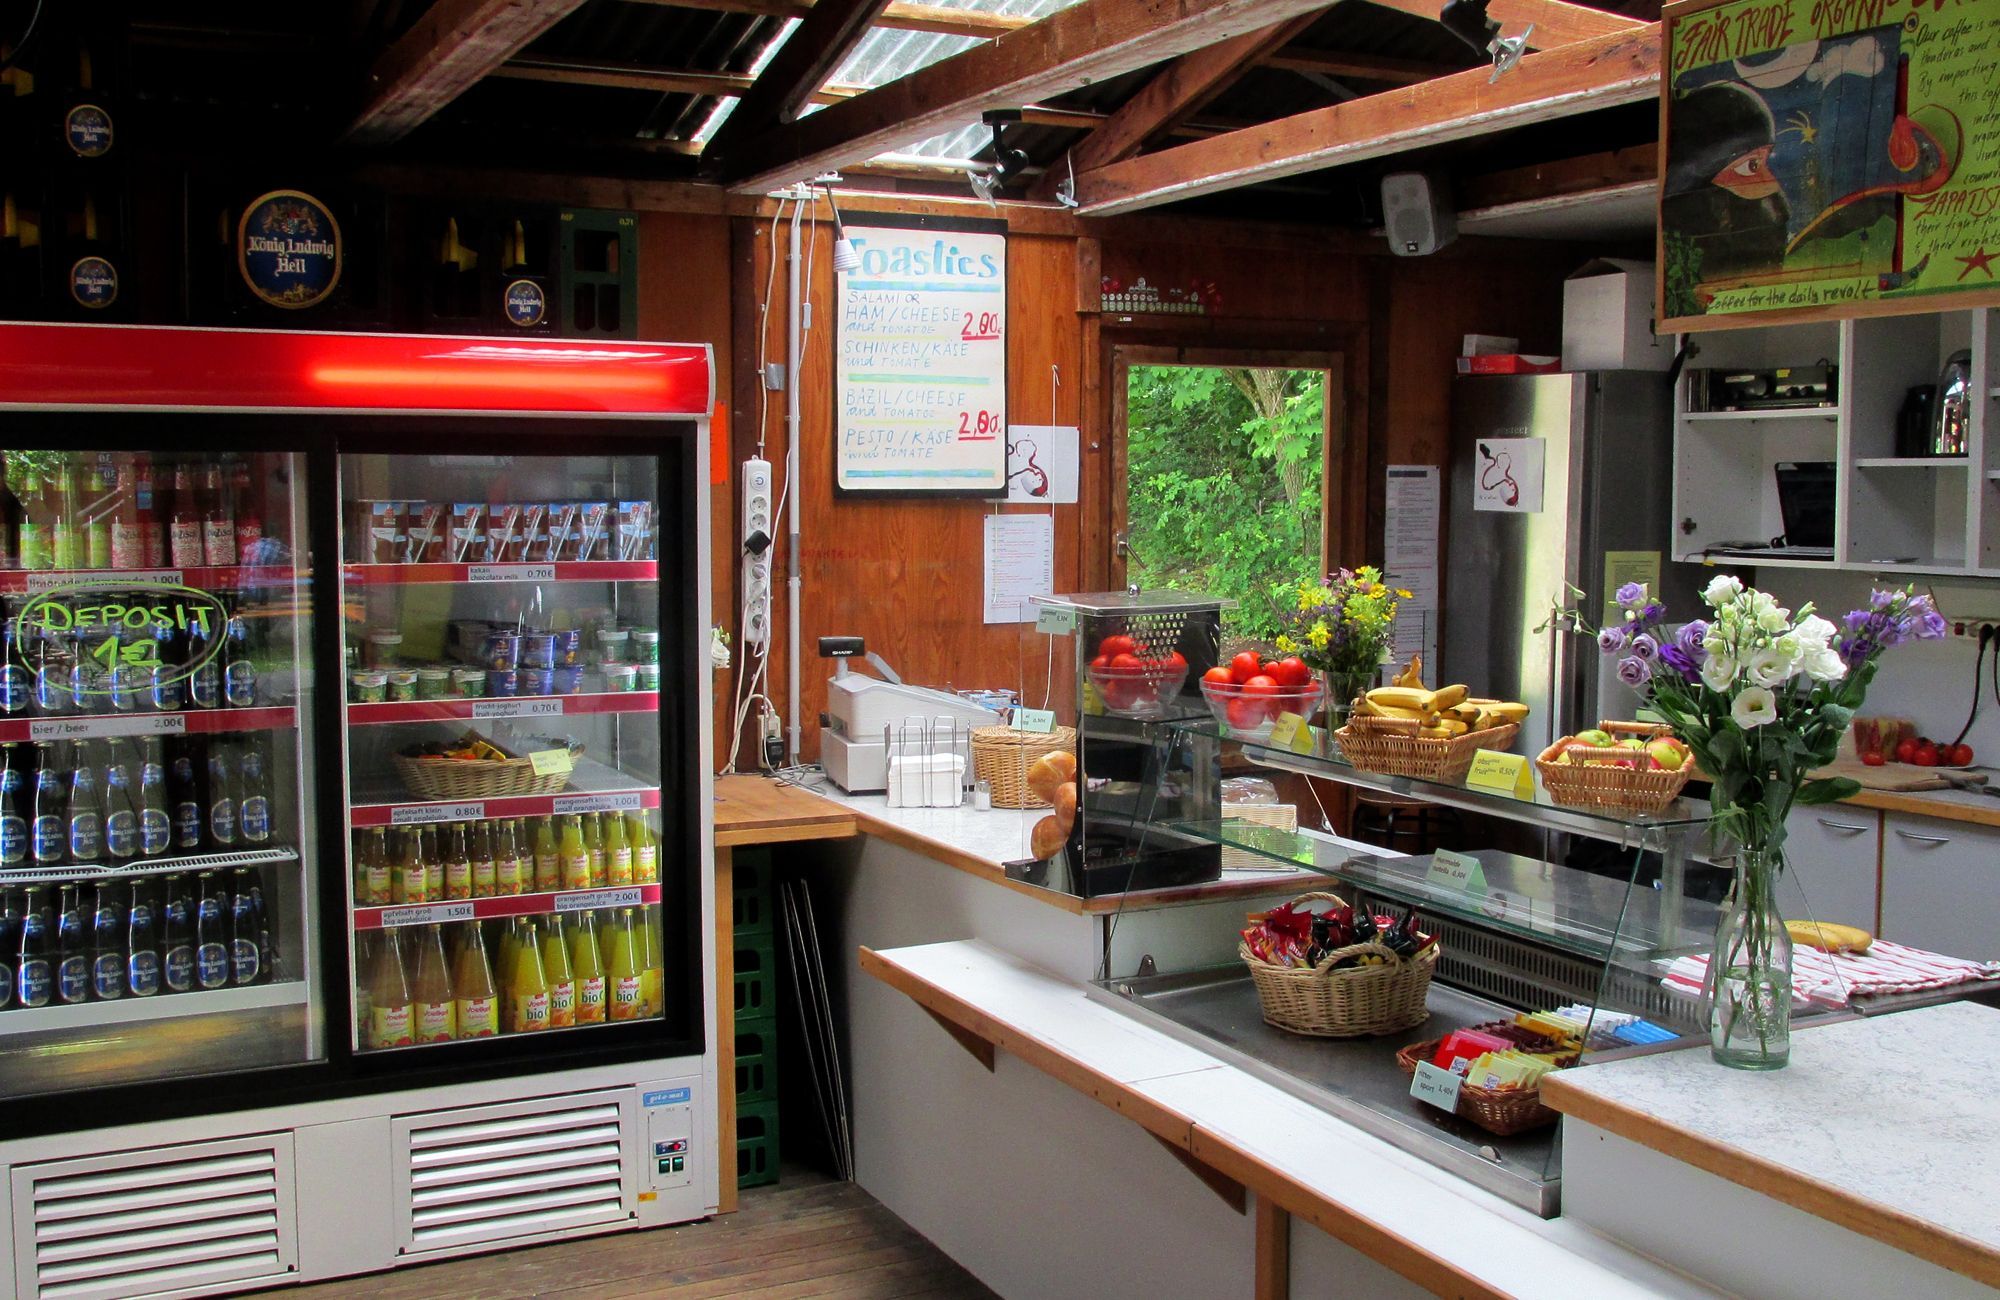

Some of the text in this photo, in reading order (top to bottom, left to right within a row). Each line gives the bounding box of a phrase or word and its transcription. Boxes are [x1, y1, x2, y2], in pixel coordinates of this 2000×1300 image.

[1735, 1, 1795, 56] TRADE
[1942, 17, 1972, 46] coffee
[1939, 59, 1997, 86] importing
[246, 236, 334, 259] König Ludwig
[274, 258, 306, 277] Hell
[847, 291, 920, 304] SALAMI OR
[1748, 291, 1763, 307] for
[1767, 288, 1785, 305] the
[1790, 284, 1818, 304] daily
[1823, 280, 1876, 300] revolt
[845, 428, 895, 446] PESTO
[884, 447, 934, 459] TOMATE
[32, 602, 214, 633] DEPOSIT
[32, 724, 53, 735] bier
[65, 723, 89, 734] beer
[552, 997, 568, 1008] bio
[581, 991, 598, 1003] bio
[616, 990, 633, 1002] bio
[526, 1009, 544, 1020] bio
